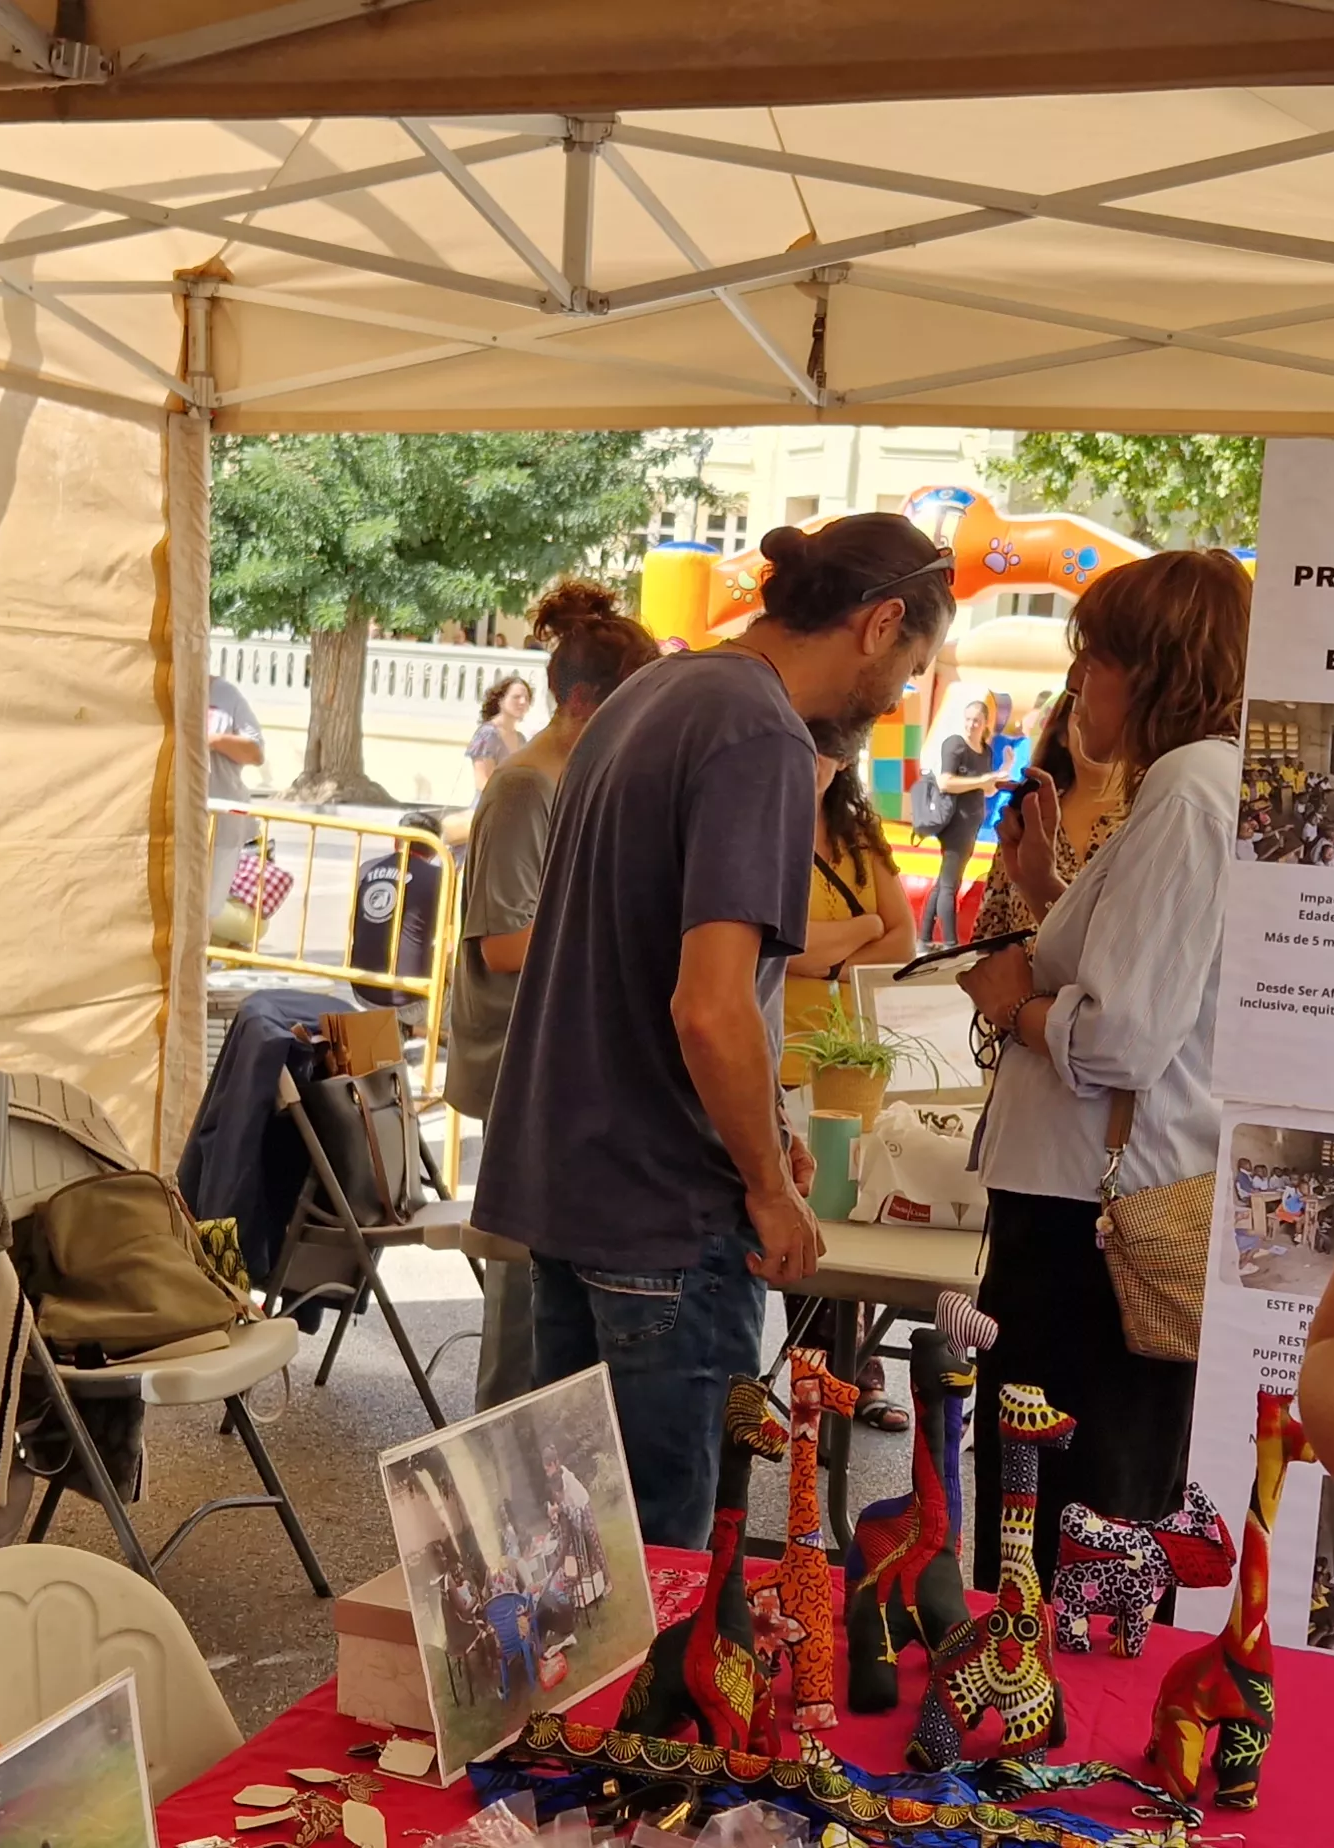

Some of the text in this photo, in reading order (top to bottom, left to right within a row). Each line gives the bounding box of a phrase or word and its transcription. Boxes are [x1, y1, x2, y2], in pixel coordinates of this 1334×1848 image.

[1264, 932, 1290, 943] Más
[1293, 934, 1309, 945] de
[1312, 936, 1319, 946] 5
[1256, 982, 1295, 995] Desde
[1298, 985, 1318, 997] Ser
[1239, 997, 1298, 1014] inclusiva,
[1267, 1299, 1295, 1312] ESTE
[1260, 1366, 1299, 1381] OPOR
